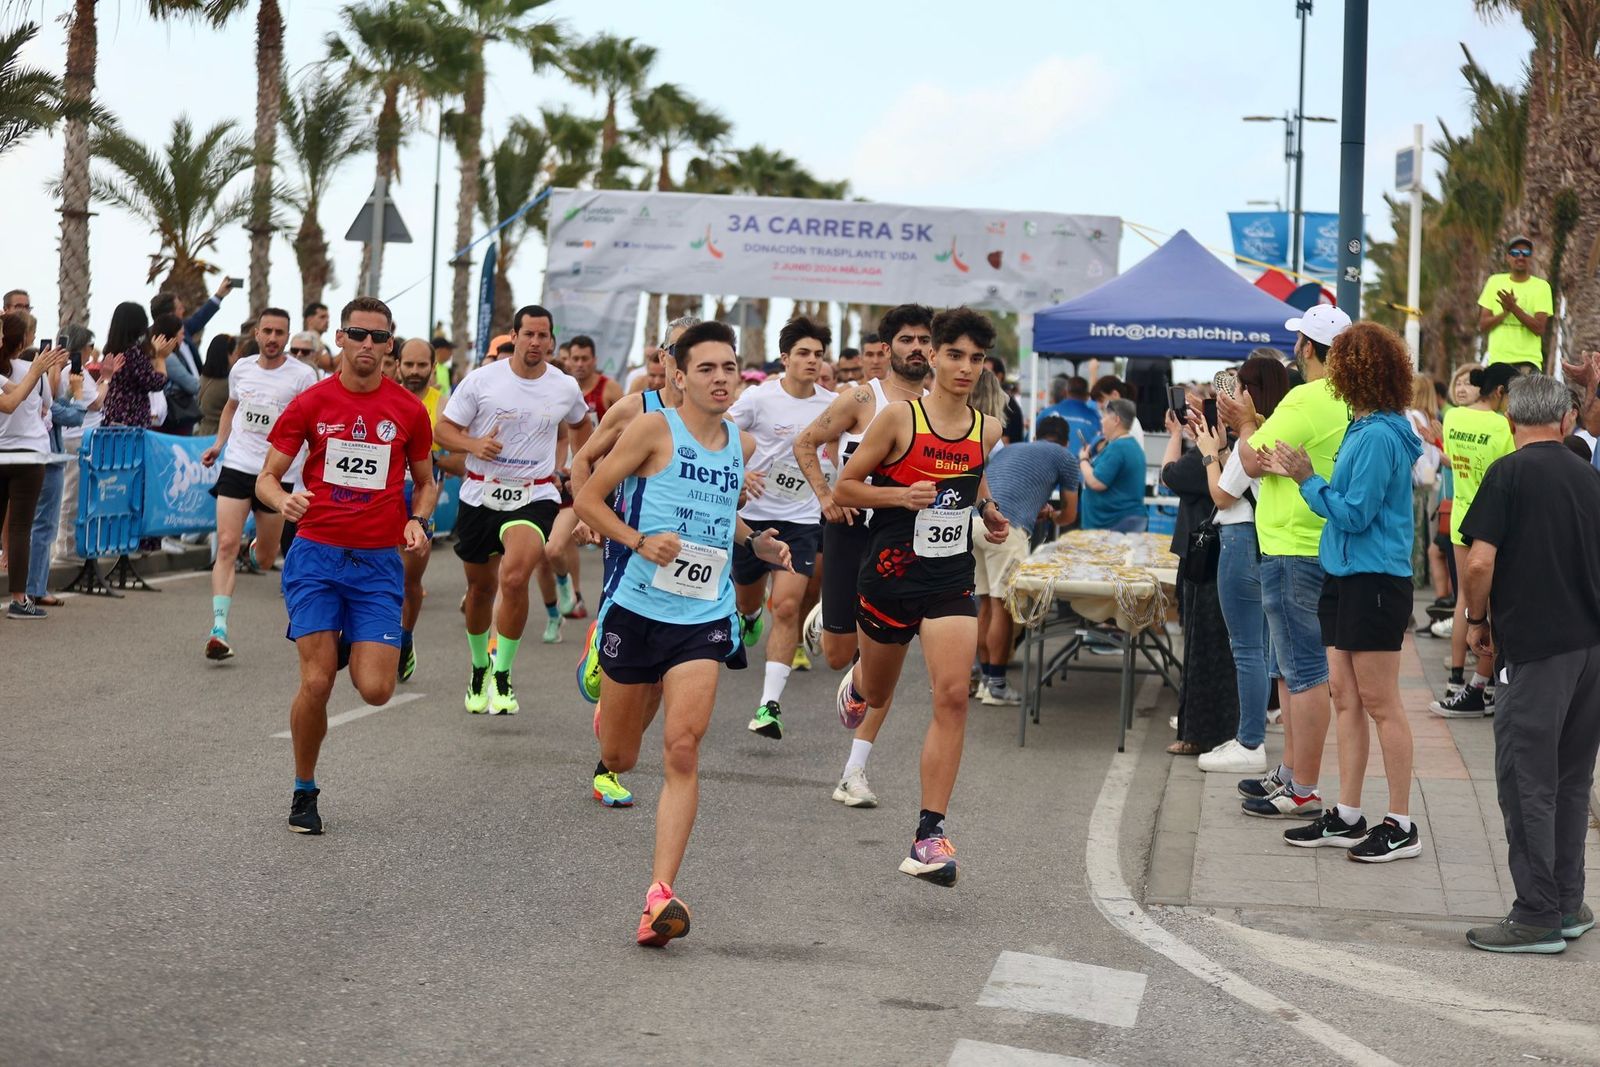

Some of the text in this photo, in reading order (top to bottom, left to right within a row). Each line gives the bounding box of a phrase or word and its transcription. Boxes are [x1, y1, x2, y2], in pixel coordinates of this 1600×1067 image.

[727, 214, 933, 242] 3A CARRERA 5K
[744, 242, 918, 262] DONACIÓN TRASPLANTE VIDA
[781, 262, 812, 273] JUNIO
[1089, 322, 1271, 345] info@dorsalchip.es
[245, 411, 270, 426] 978
[923, 446, 969, 464] Málaga
[336, 456, 378, 475] 425
[935, 459, 969, 472] Bahía
[678, 461, 739, 493] nerja
[776, 473, 806, 491] 887
[491, 487, 523, 501] 403
[687, 489, 733, 507] ATLETISMO
[694, 510, 711, 518] metro
[927, 524, 963, 543] 368
[673, 558, 713, 584] 760
